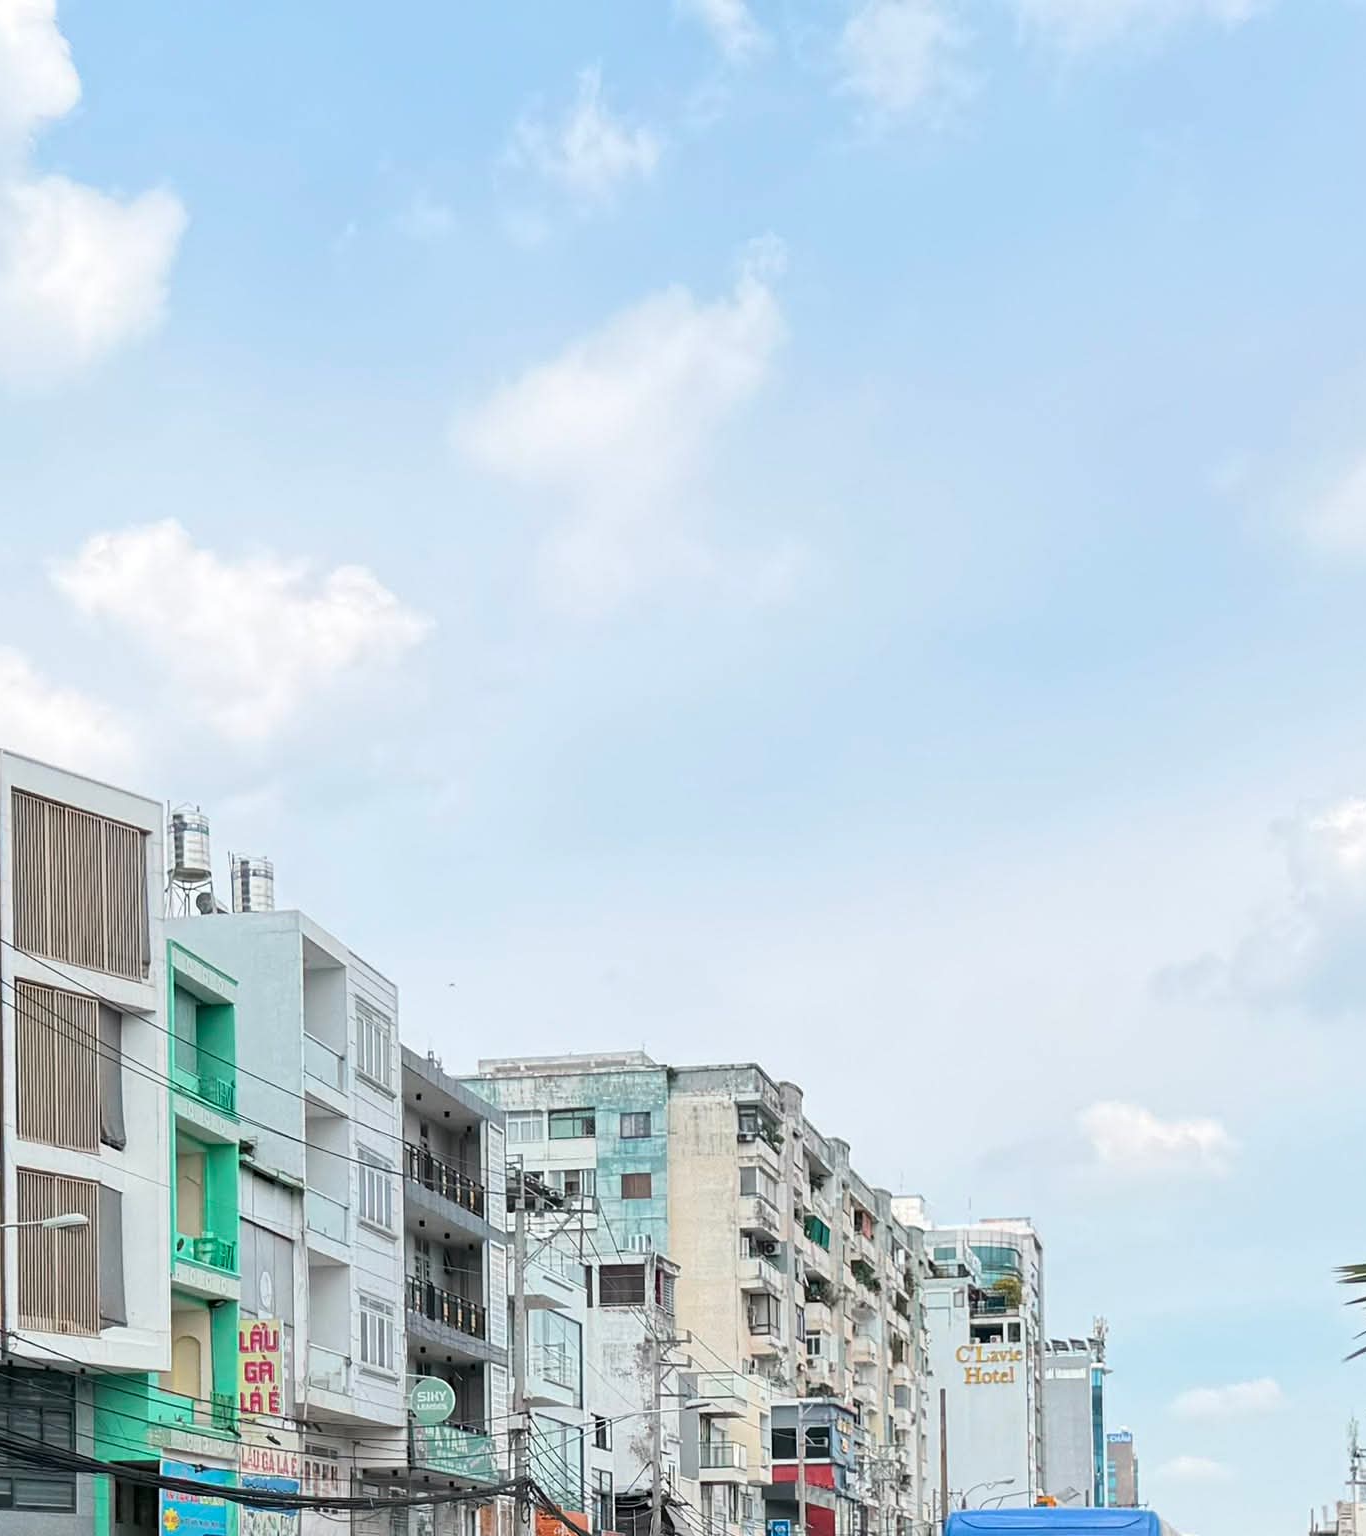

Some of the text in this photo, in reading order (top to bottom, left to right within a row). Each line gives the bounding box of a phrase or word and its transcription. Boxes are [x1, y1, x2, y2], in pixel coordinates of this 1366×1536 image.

[238, 1321, 280, 1354] LẨU
[244, 1353, 275, 1384] GÀ
[963, 1365, 1016, 1385] Hotel
